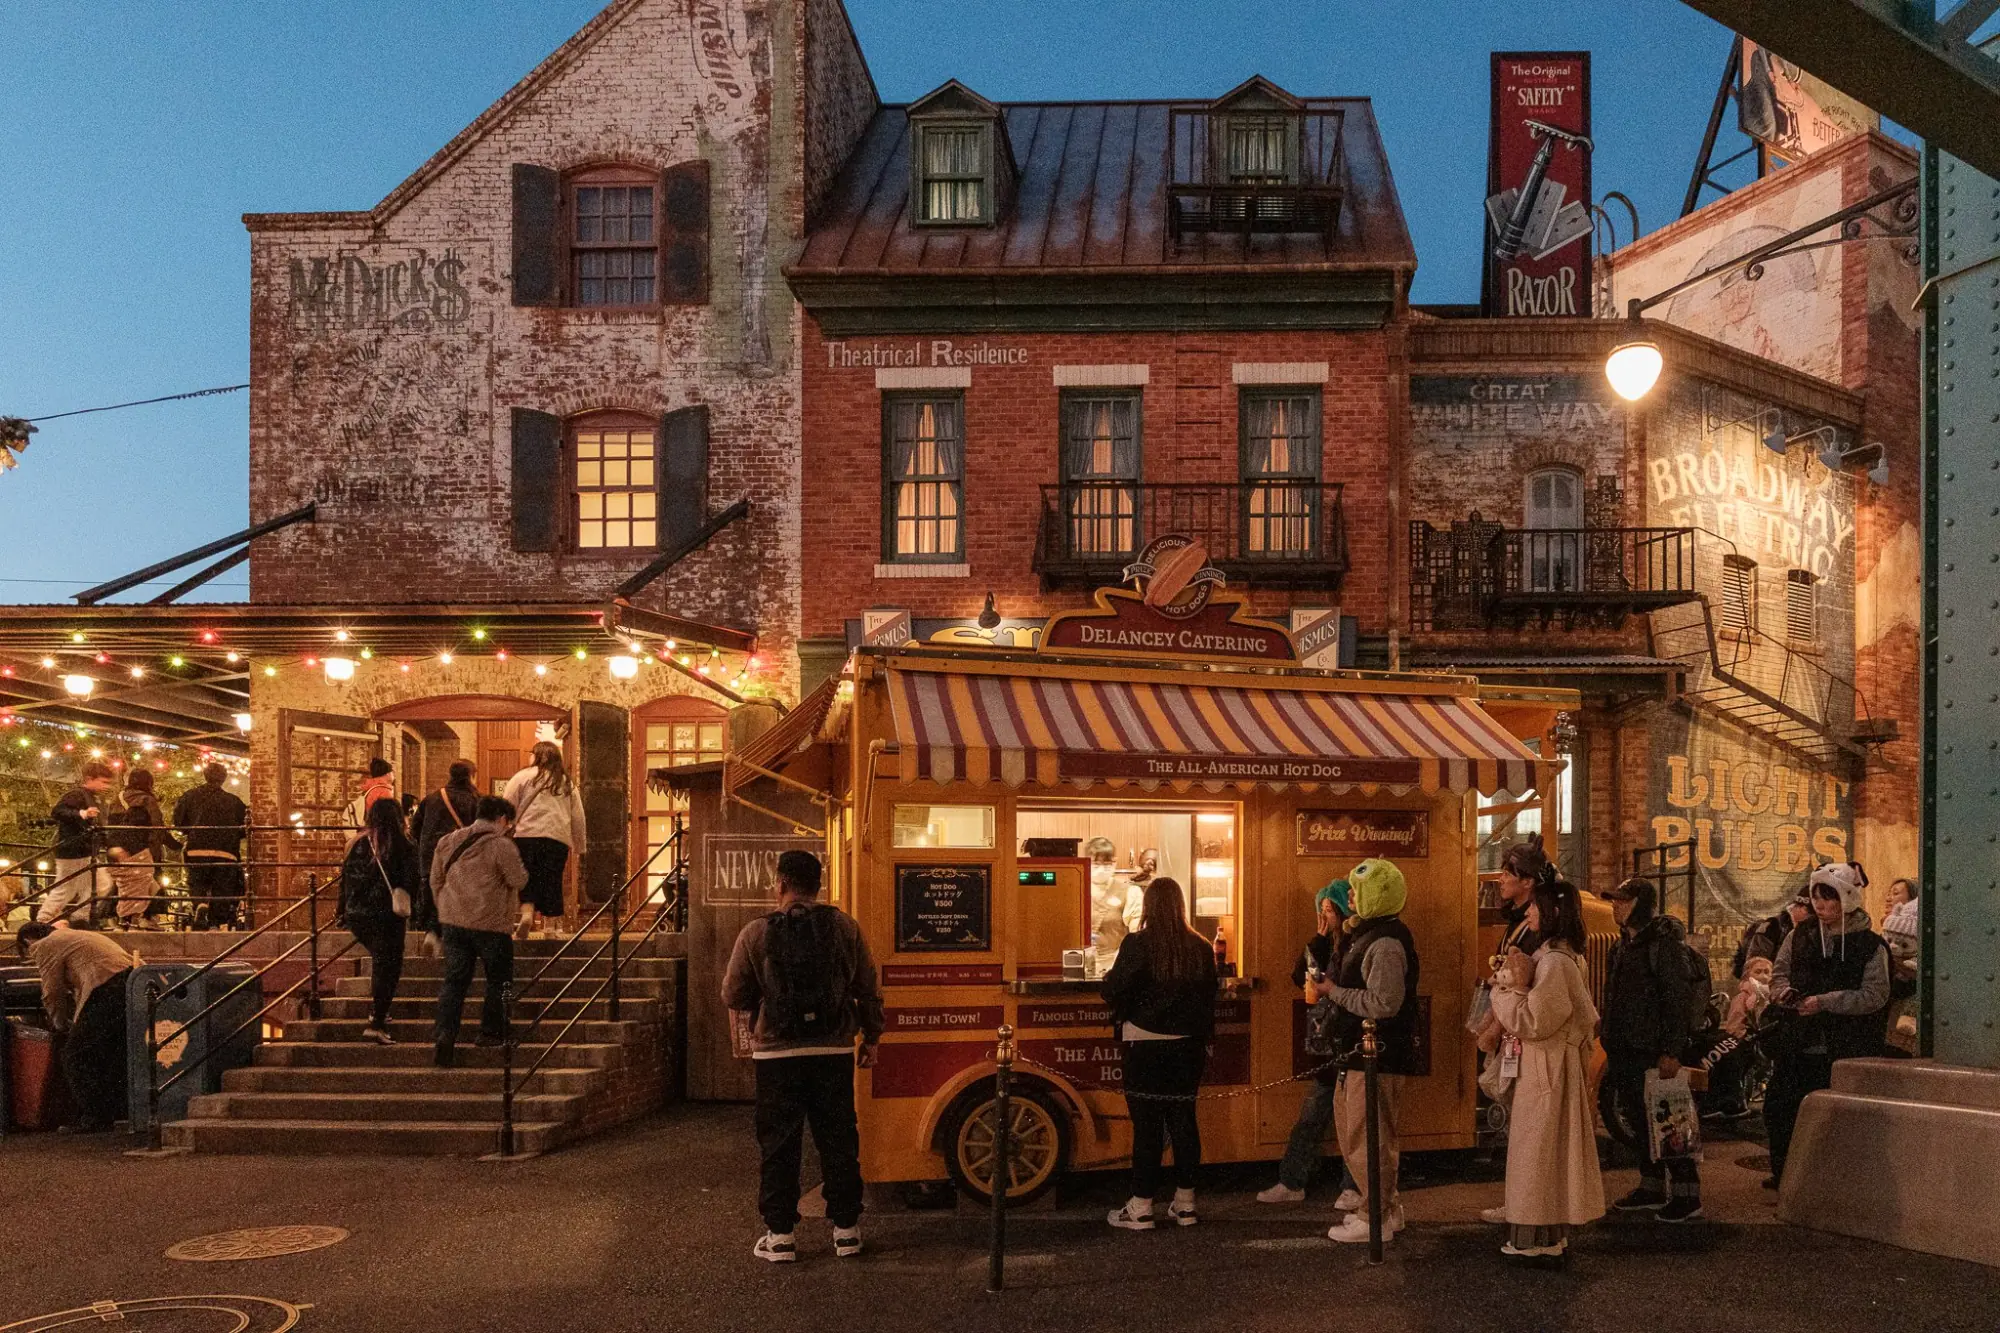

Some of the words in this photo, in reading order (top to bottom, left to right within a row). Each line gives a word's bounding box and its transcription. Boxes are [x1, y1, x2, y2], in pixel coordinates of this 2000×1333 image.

[1512, 64, 1531, 76] The
[1532, 65, 1571, 79] Original
[1507, 266, 1577, 317] RAZOR
[821, 341, 920, 368] Theatrical
[931, 340, 1028, 367] Residence
[1470, 383, 1551, 400] GREAT
[1537, 402, 1613, 430] WAY
[1650, 449, 1854, 552] BROADWAY
[1670, 500, 1835, 584] ELECTRIC
[1165, 605, 1187, 615] HOT
[1189, 584, 1208, 610] DOGS
[1296, 613, 1312, 628] THE
[1080, 624, 1176, 647] DELANCEY
[1179, 630, 1269, 653] CATERING
[1147, 760, 1174, 773] THE
[1177, 760, 1278, 776] ALL-AMERICAN
[1283, 763, 1309, 776] HOT
[1312, 764, 1341, 777] DOG
[1667, 755, 1850, 818] LIGHT
[1308, 822, 1347, 841] Prize
[1350, 824, 1416, 846] Winning!
[1651, 815, 1848, 873] BULBS
[897, 1014, 925, 1025] BEST
[928, 1015, 940, 1025] IN
[942, 1012, 980, 1025] TOWN!
[1033, 1011, 1074, 1022] FAMOUS
[1054, 1047, 1086, 1063] THE
